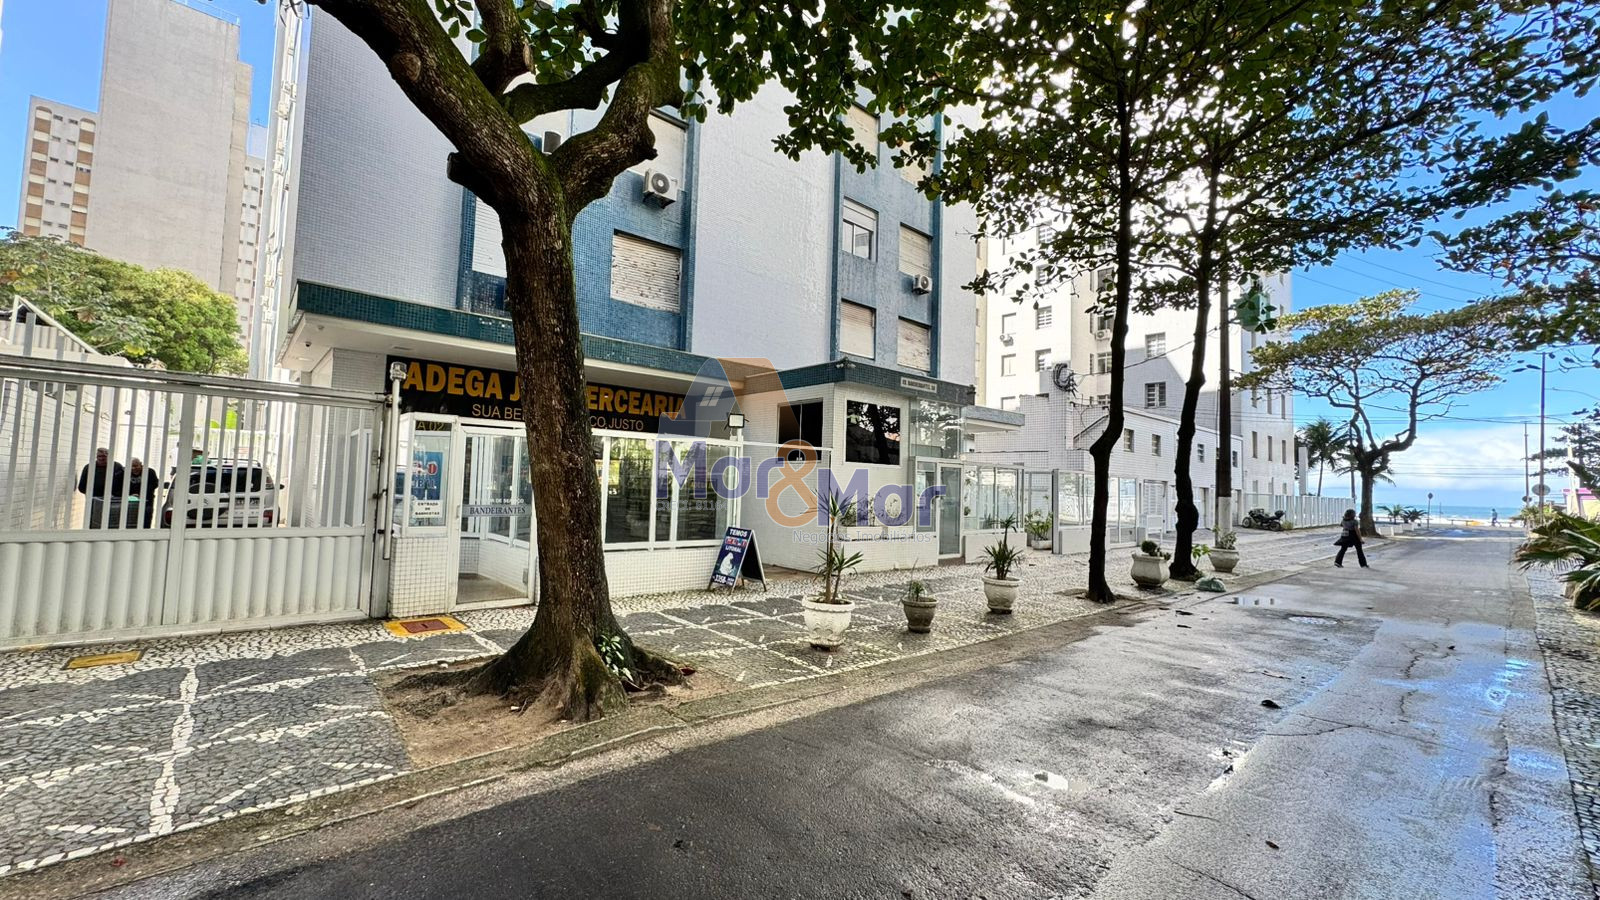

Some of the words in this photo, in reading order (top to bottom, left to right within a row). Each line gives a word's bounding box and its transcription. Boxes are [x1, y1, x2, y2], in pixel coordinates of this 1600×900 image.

[403, 361, 503, 400] ADEGA
[587, 386, 686, 418] ERCEARIA
[472, 403, 501, 419] SUA
[608, 417, 644, 431] JUSTO
[469, 506, 526, 516] BANDEIRANTES
[729, 528, 748, 537] TEMOS
